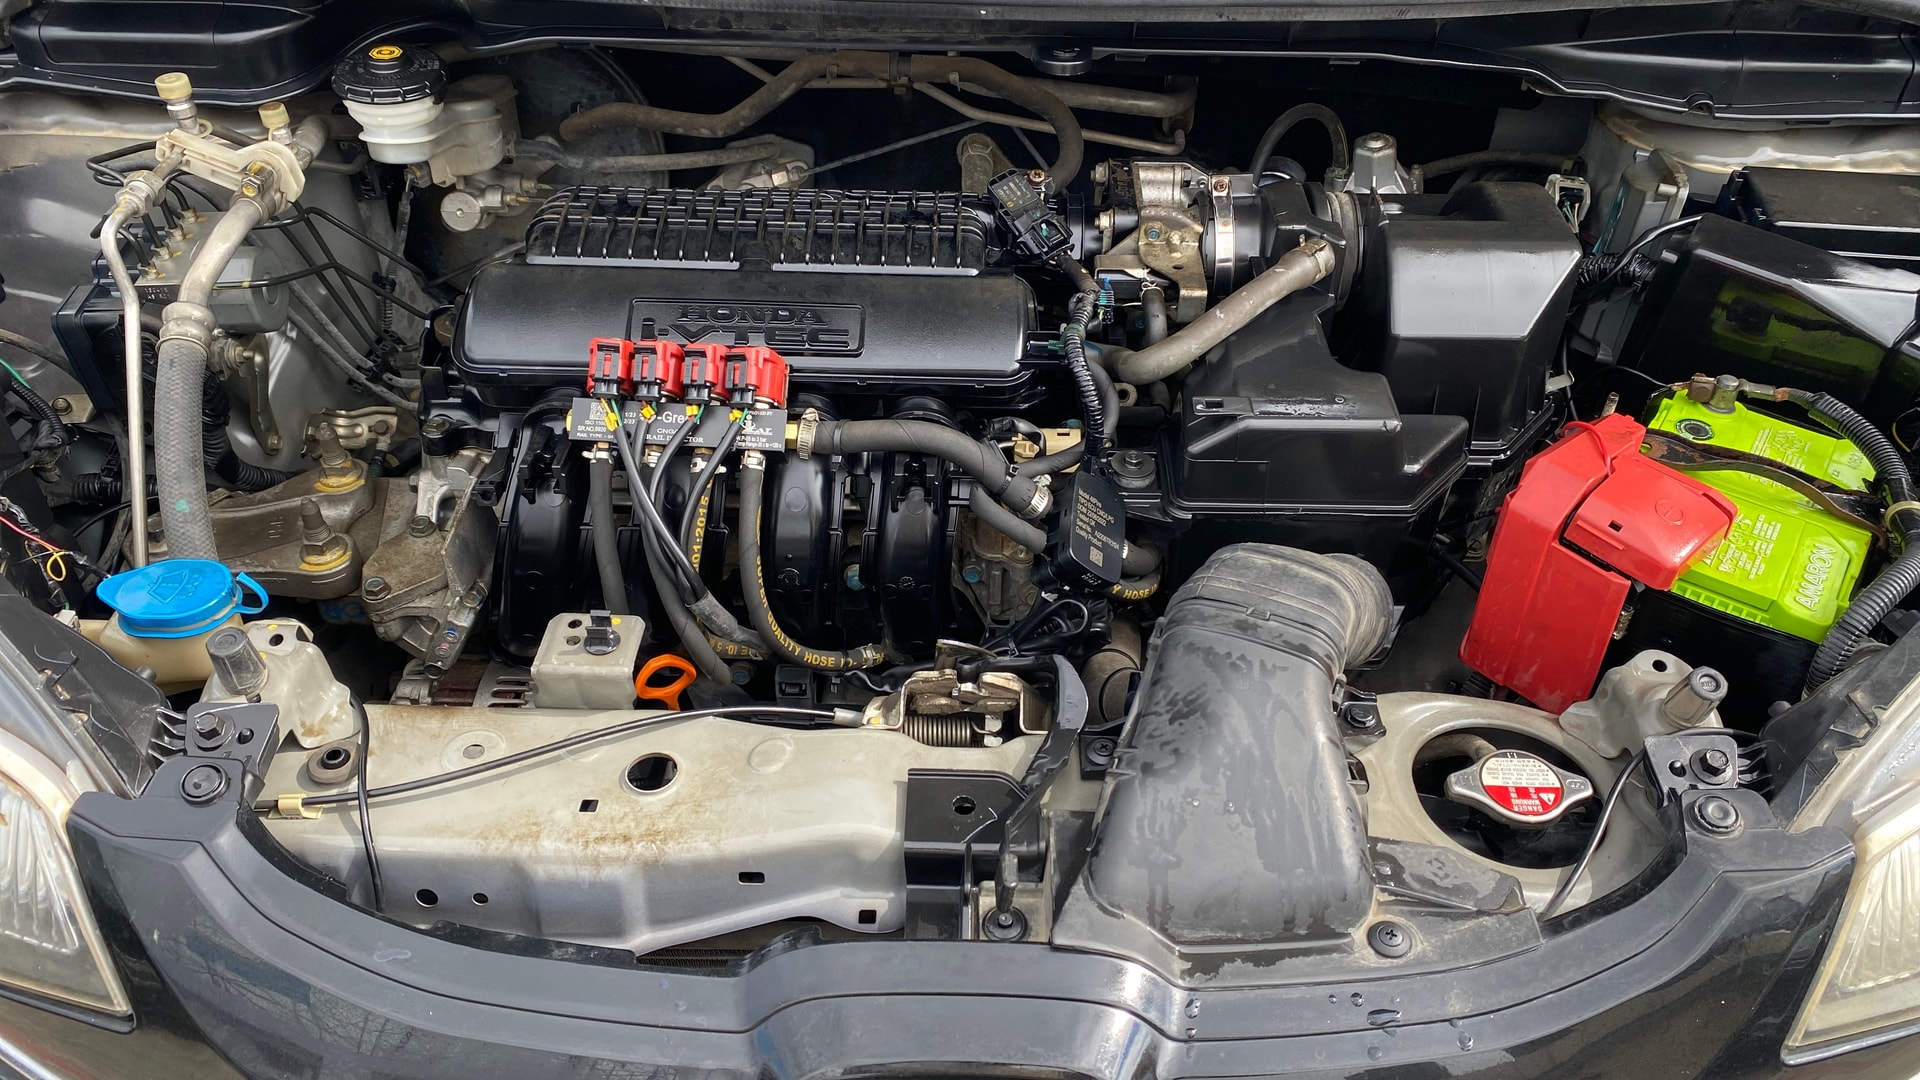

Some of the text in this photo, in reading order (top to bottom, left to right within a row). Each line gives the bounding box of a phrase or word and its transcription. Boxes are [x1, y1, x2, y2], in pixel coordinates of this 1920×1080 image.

[677, 305, 828, 327] HONDA
[1796, 543, 1837, 611] AMARON
[767, 611, 802, 656] QUALITY
[803, 651, 836, 668] HOSE
[1511, 798, 1541, 806] WARNING
